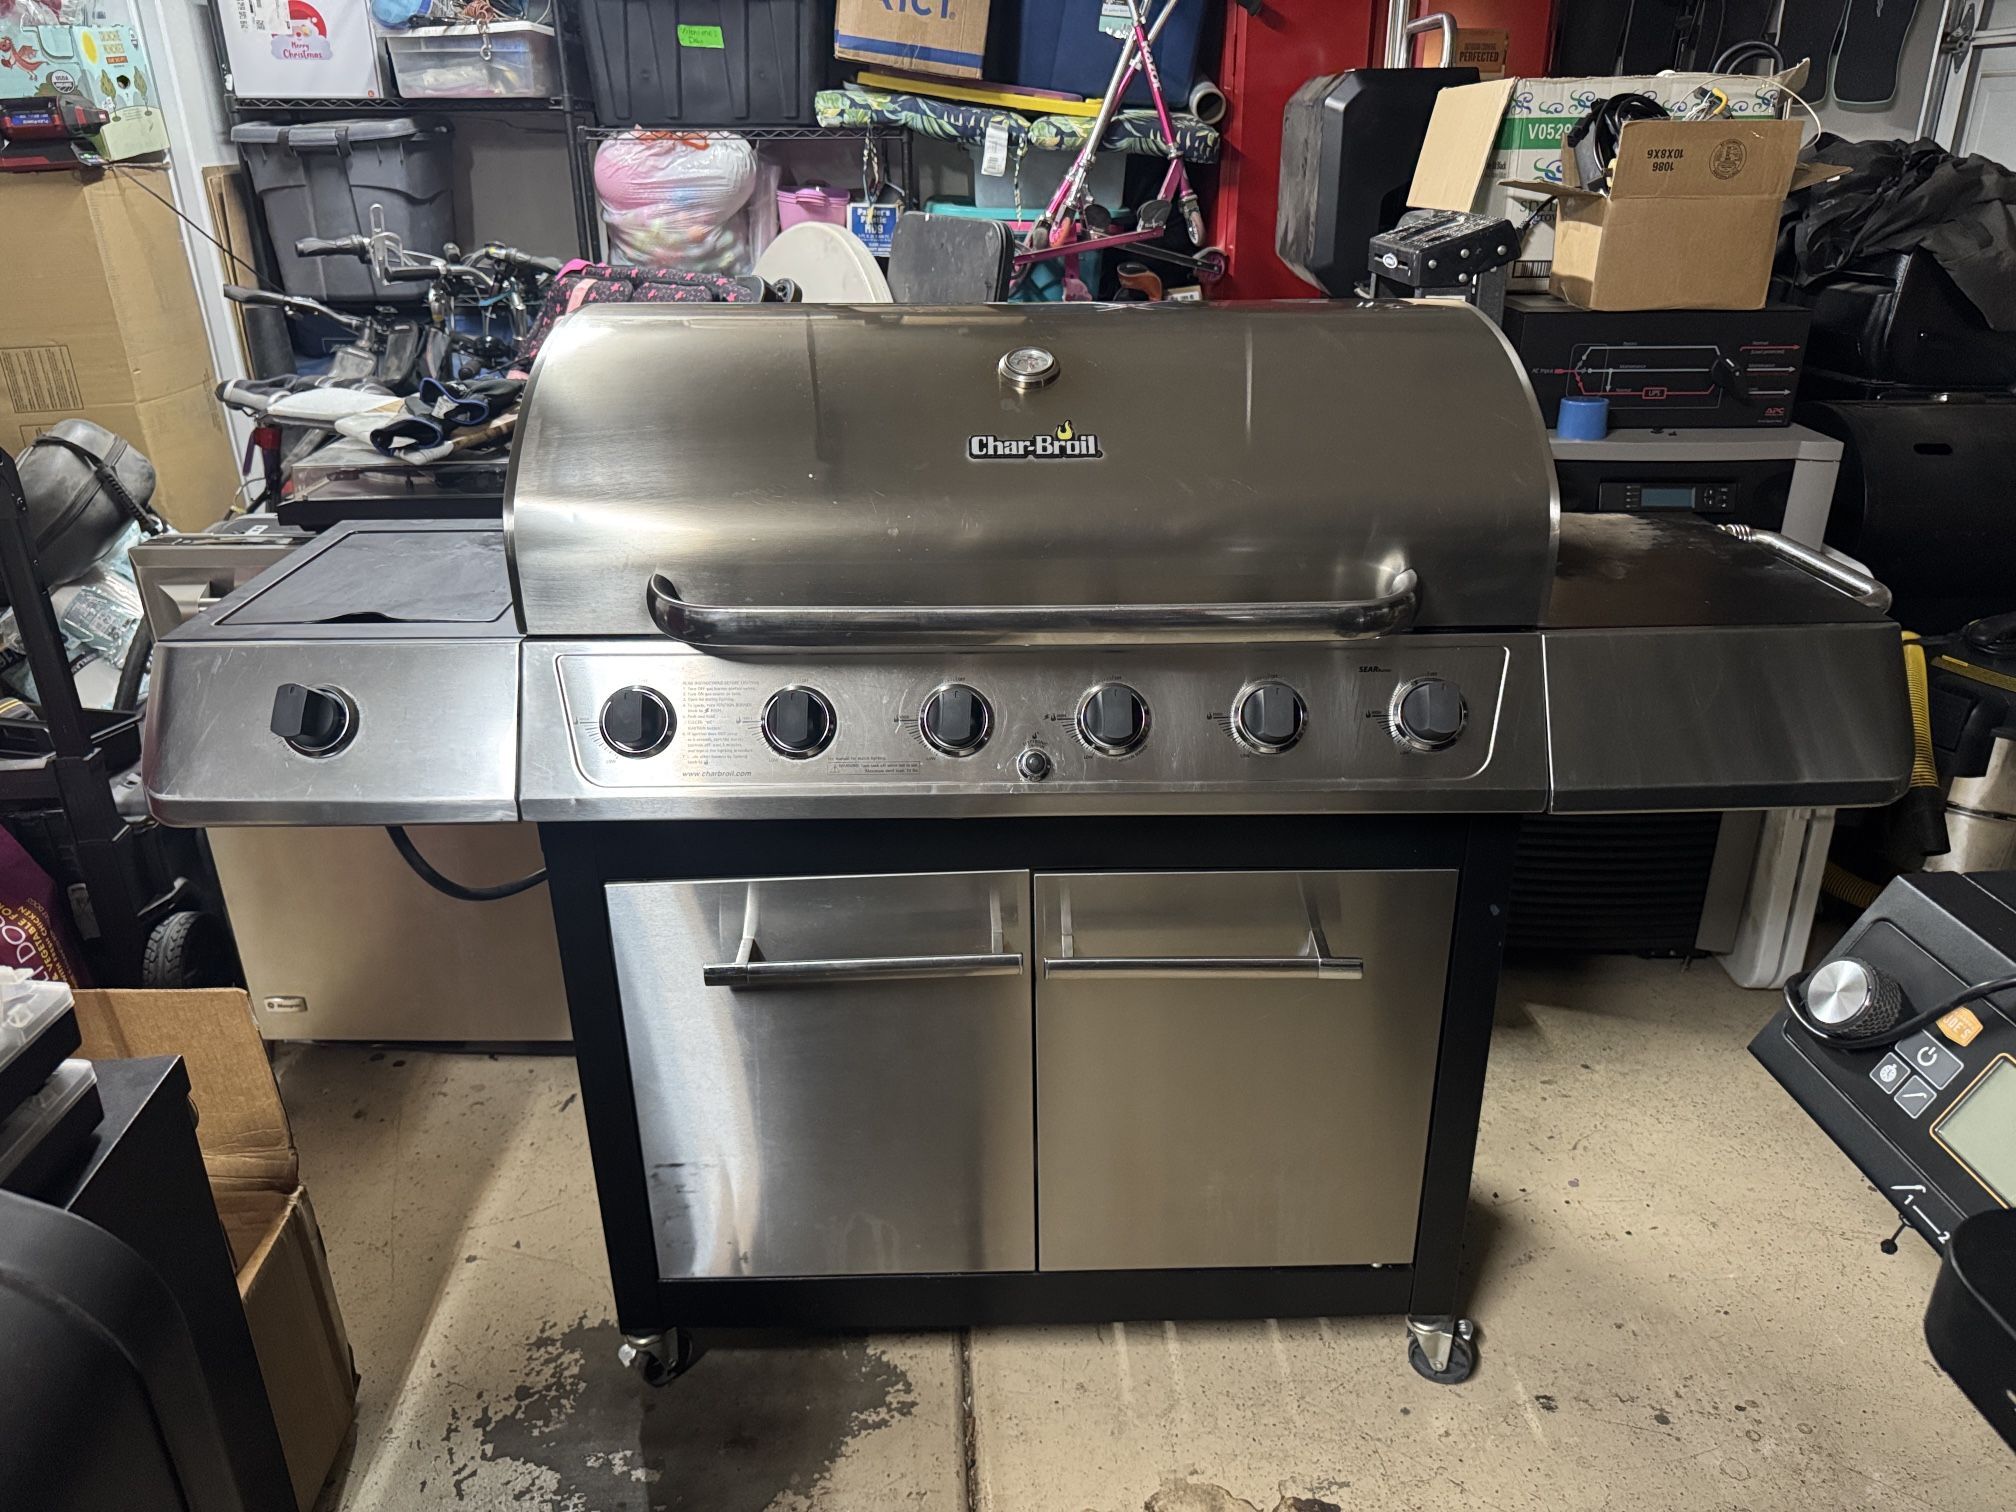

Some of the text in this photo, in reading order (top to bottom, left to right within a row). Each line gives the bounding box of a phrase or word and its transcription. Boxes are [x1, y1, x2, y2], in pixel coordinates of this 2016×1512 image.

[291, 41, 310, 50] Merry
[283, 48, 323, 59] Christmas
[1459, 51, 1499, 62] PERFECTED
[1647, 149, 1684, 159] 10X8X6
[1652, 161, 1675, 172] 1086
[970, 434, 1098, 457] Char-Broil
[682, 769, 752, 777] www.charbroil.com
[18, 905, 48, 937] CHICKEN
[17, 918, 53, 972] VEGETABLE
[1903, 1194, 1914, 1205] 1
[1937, 1231, 1951, 1244] 2
